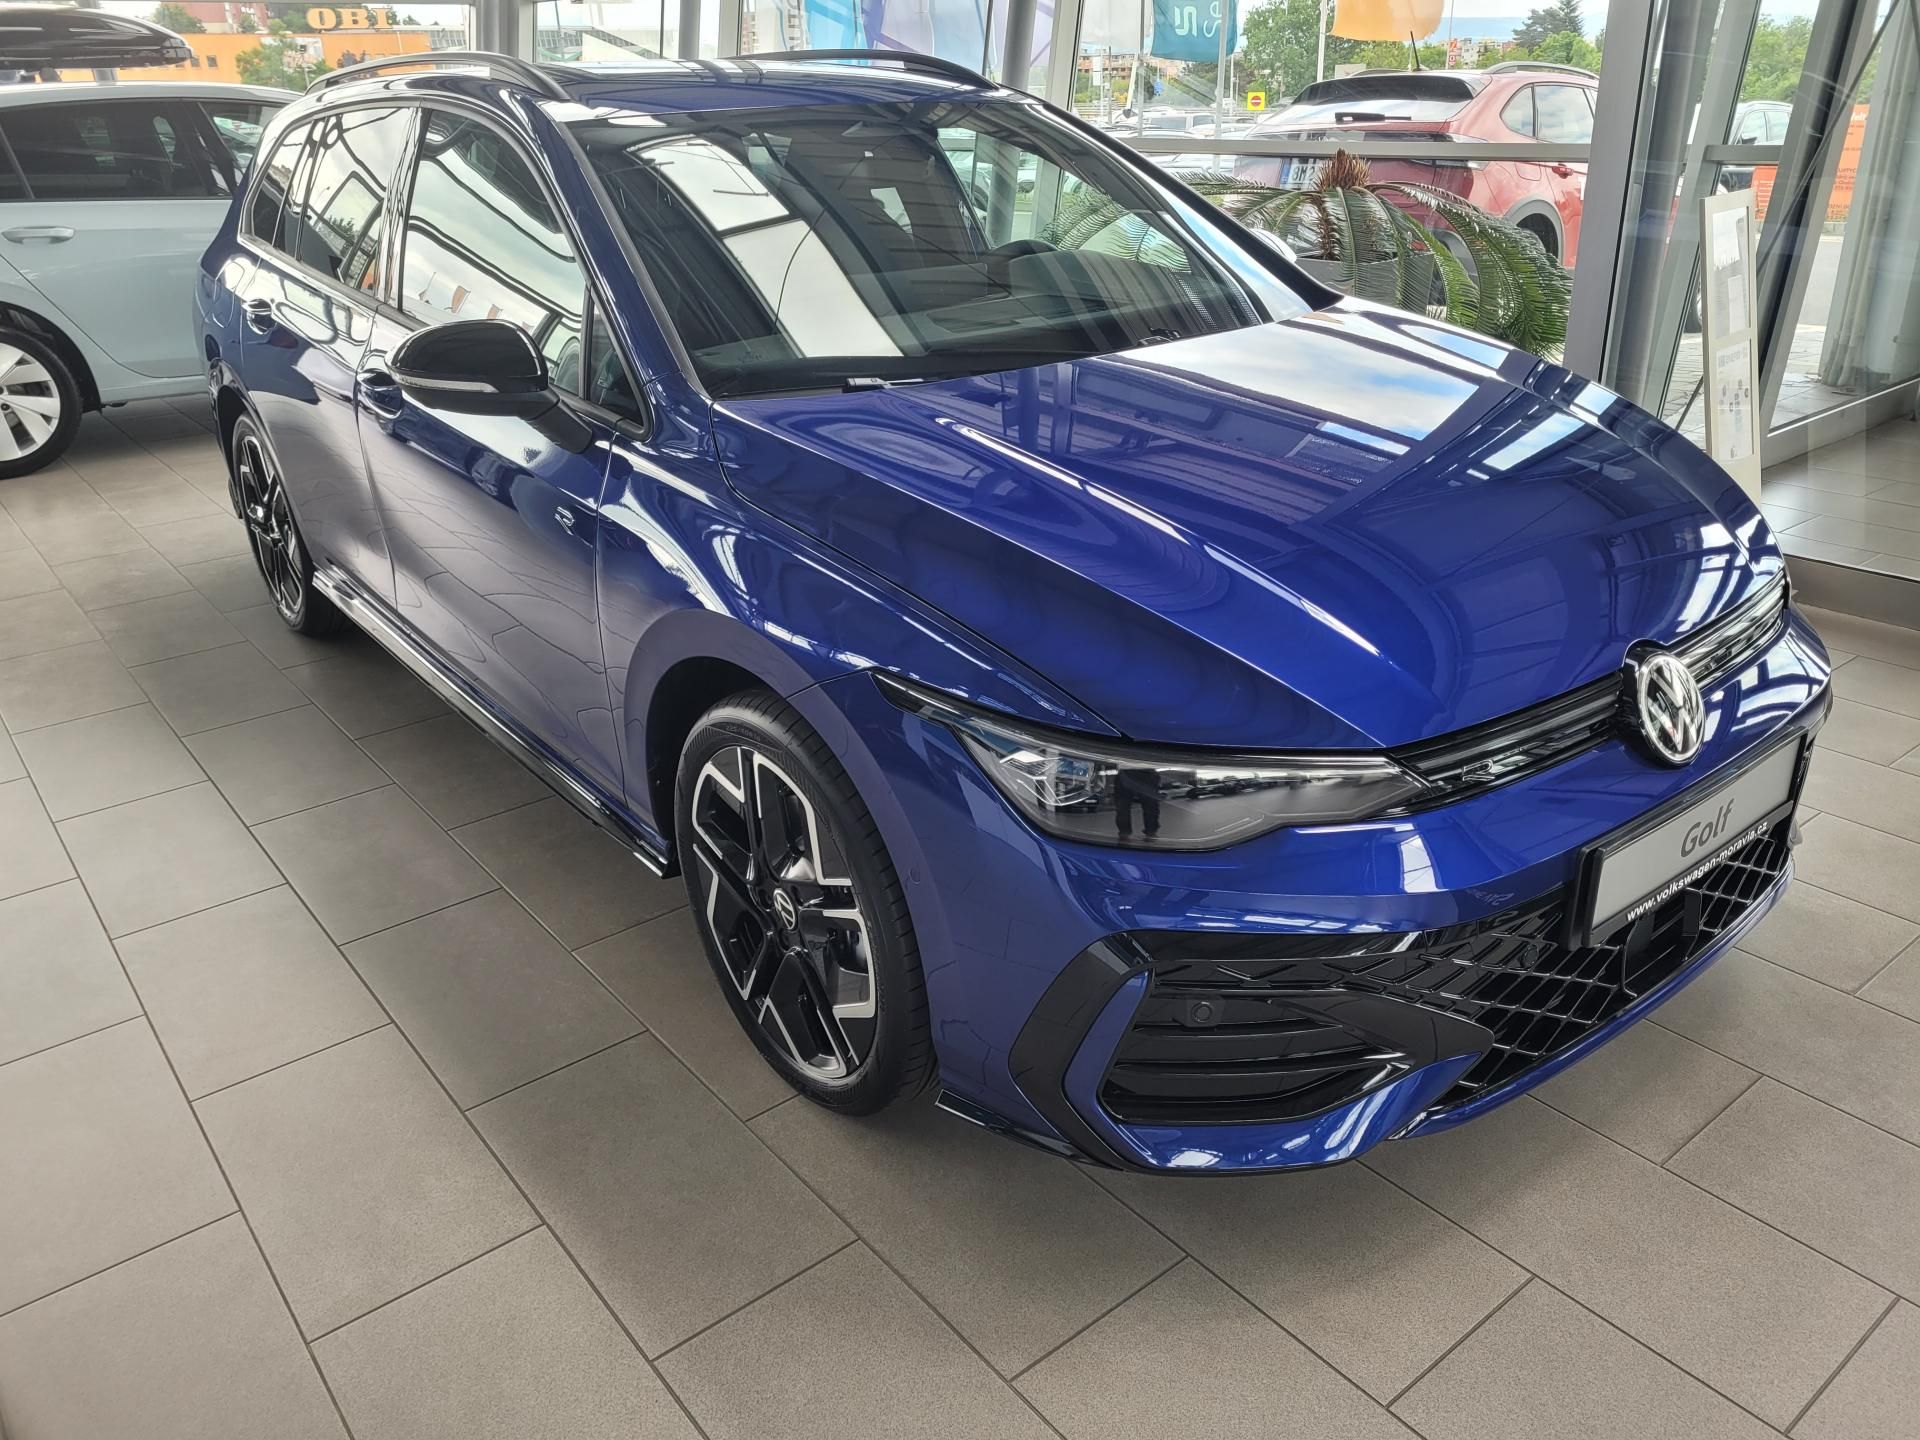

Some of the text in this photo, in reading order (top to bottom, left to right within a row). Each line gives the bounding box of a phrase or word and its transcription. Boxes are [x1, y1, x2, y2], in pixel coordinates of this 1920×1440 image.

[306, 7, 393, 30] OBI
[1680, 798, 1735, 858] Golf
[1626, 822, 1768, 921] www.volkswagen-moravia.cz
